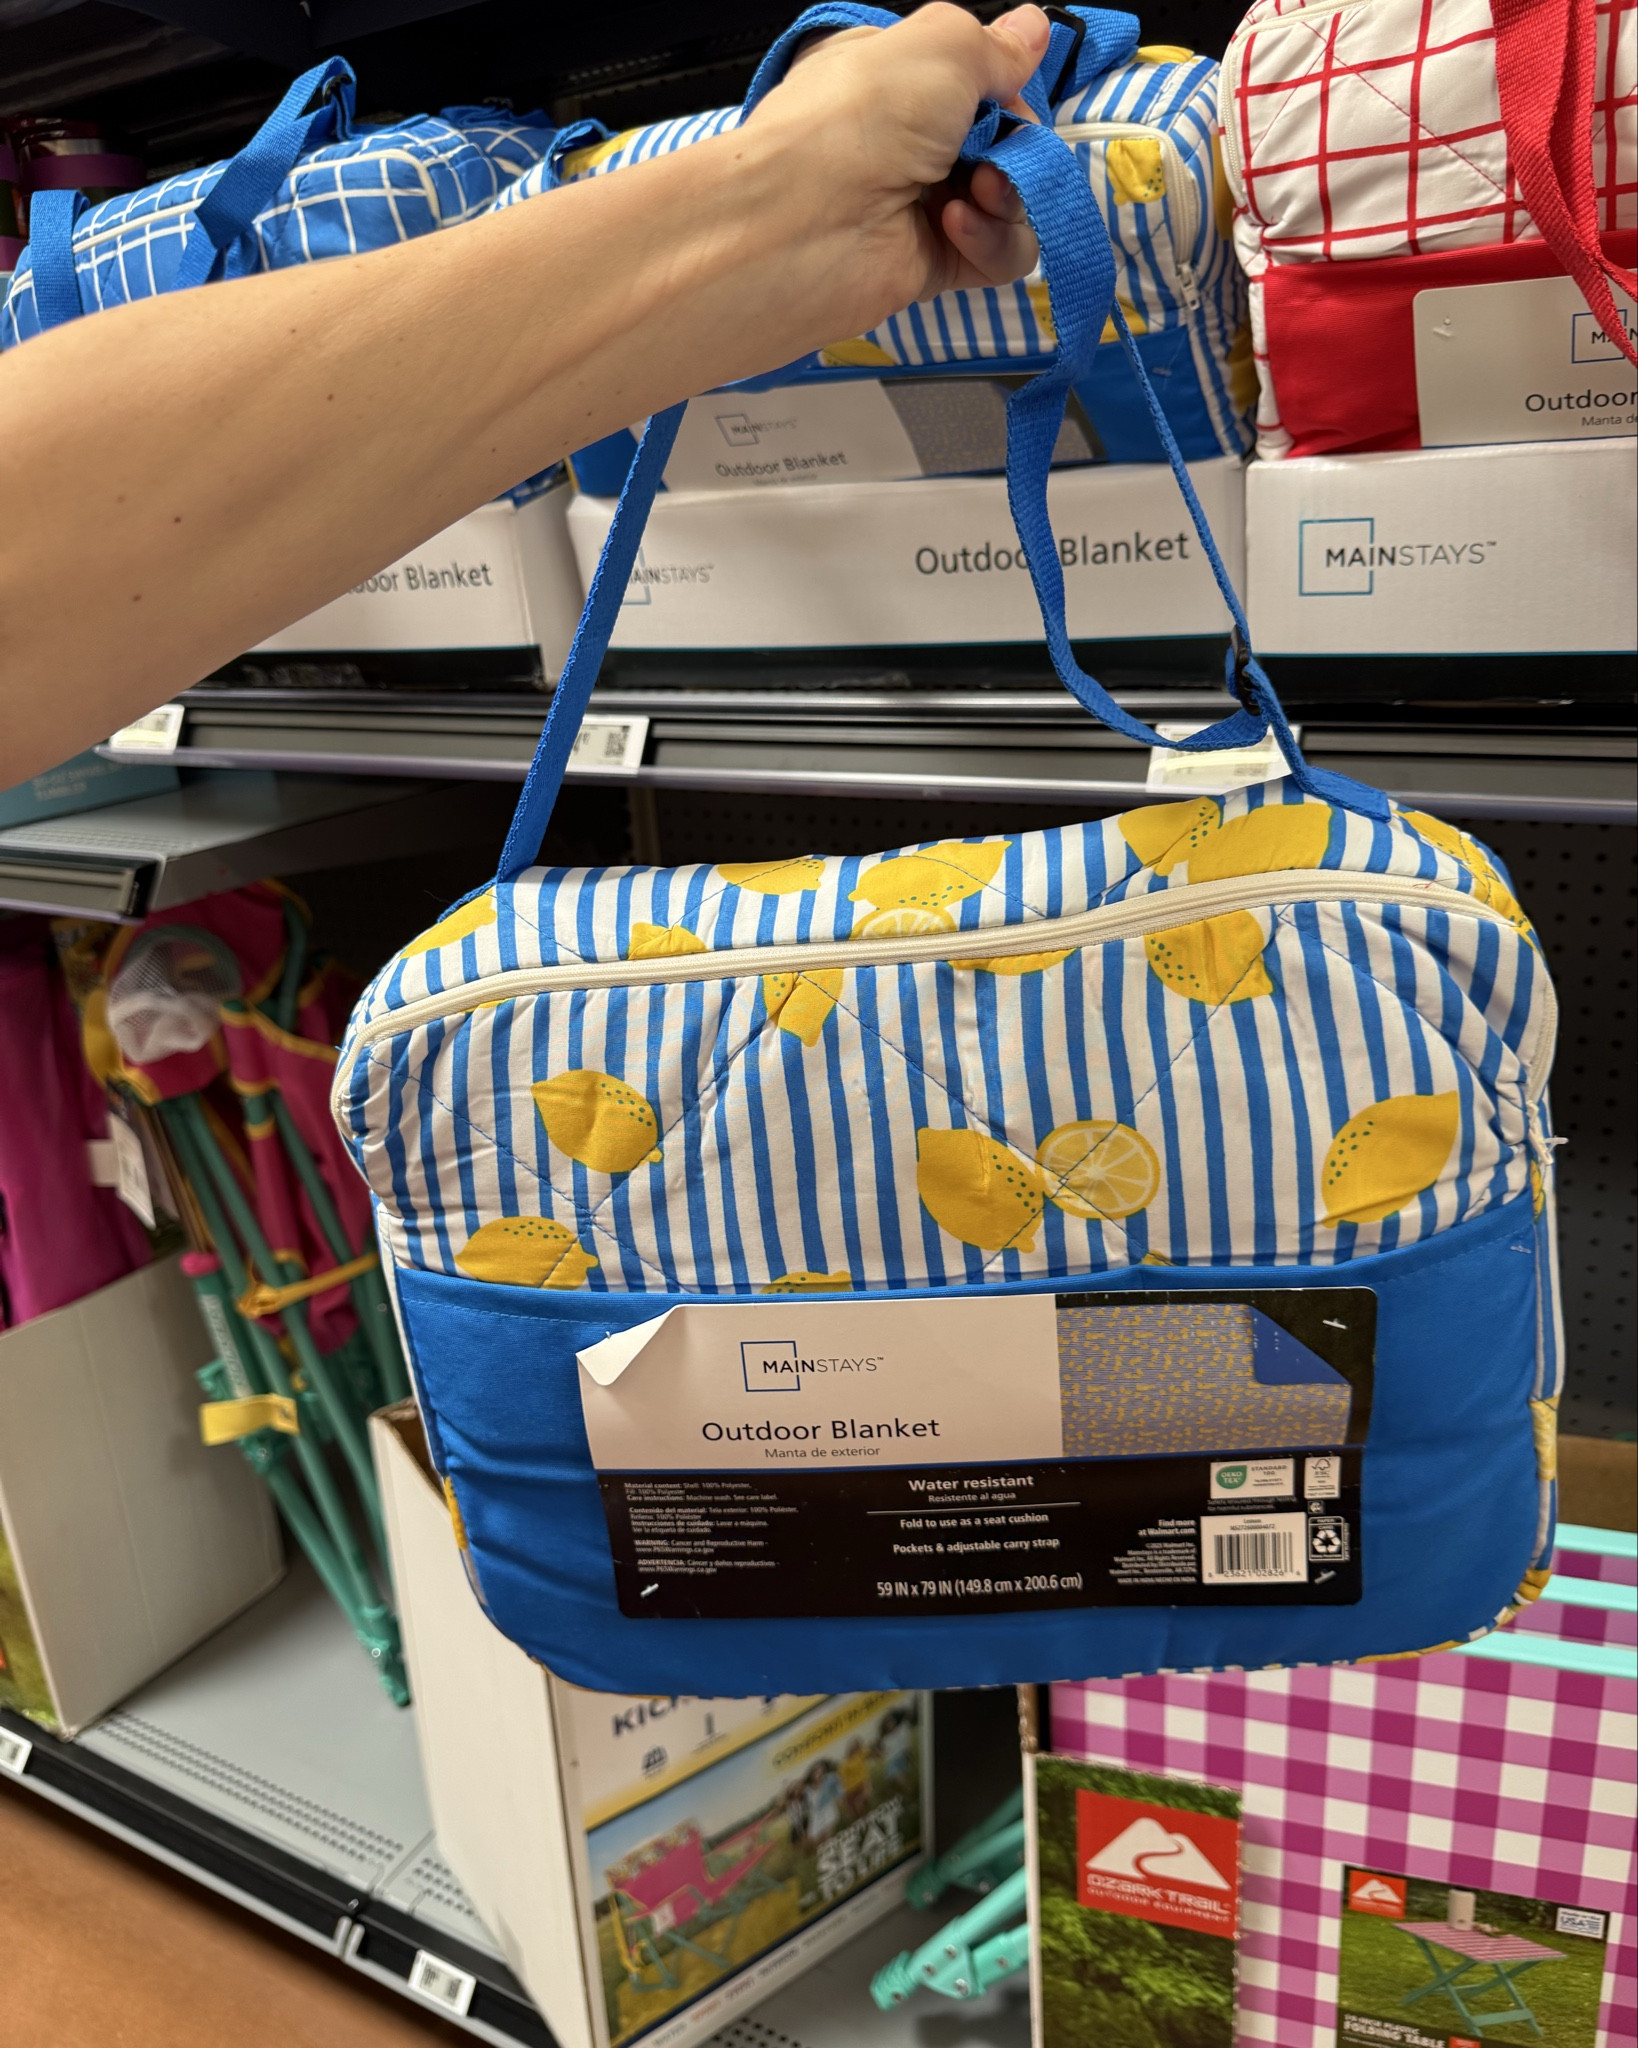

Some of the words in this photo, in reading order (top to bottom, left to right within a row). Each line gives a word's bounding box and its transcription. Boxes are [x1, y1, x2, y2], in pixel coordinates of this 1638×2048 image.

[1582, 416, 1622, 426] Manta
[715, 460, 781, 477] Outdoor
[782, 451, 848, 472] Blanket
[915, 541, 1028, 575] Outdoo
[1059, 531, 1190, 567] Blanket
[404, 561, 493, 591] Blanket
[702, 1421, 821, 1441] Outdoor
[831, 1417, 941, 1439] Blanket
[764, 1448, 807, 1458] Manta
[811, 1447, 827, 1457] de
[831, 1446, 880, 1457] exterior
[908, 1479, 959, 1492] Water
[964, 1475, 1034, 1489] resistant
[928, 1493, 977, 1502] Resistente
[980, 1492, 989, 1500] al
[991, 1492, 1016, 1501] agua
[900, 1518, 922, 1529] Fold
[925, 1518, 936, 1528] to
[939, 1519, 957, 1527] use
[960, 1518, 971, 1526] as
[974, 1517, 981, 1526] a
[983, 1515, 1006, 1525] seat
[1008, 1512, 1049, 1524] cushion
[893, 1543, 933, 1554] Pockets
[936, 1543, 944, 1552] &
[947, 1540, 1000, 1554] adjustable
[1003, 1539, 1030, 1551] carry
[1032, 1538, 1060, 1549] strap
[877, 1581, 893, 1596] 59
[895, 1581, 909, 1596] IN
[911, 1584, 919, 1596] x
[921, 1580, 936, 1595] 79
[939, 1579, 953, 1595] IN
[955, 1578, 992, 1597] (149.8
[994, 1580, 1013, 1592] cm
[1014, 1579, 1023, 1591] x
[1024, 1575, 1058, 1591] 200.6
[1061, 1572, 1083, 1590] cm)
[1343, 2020, 1402, 2042] FOLDING
[1404, 2034, 1447, 2048] TABLE
